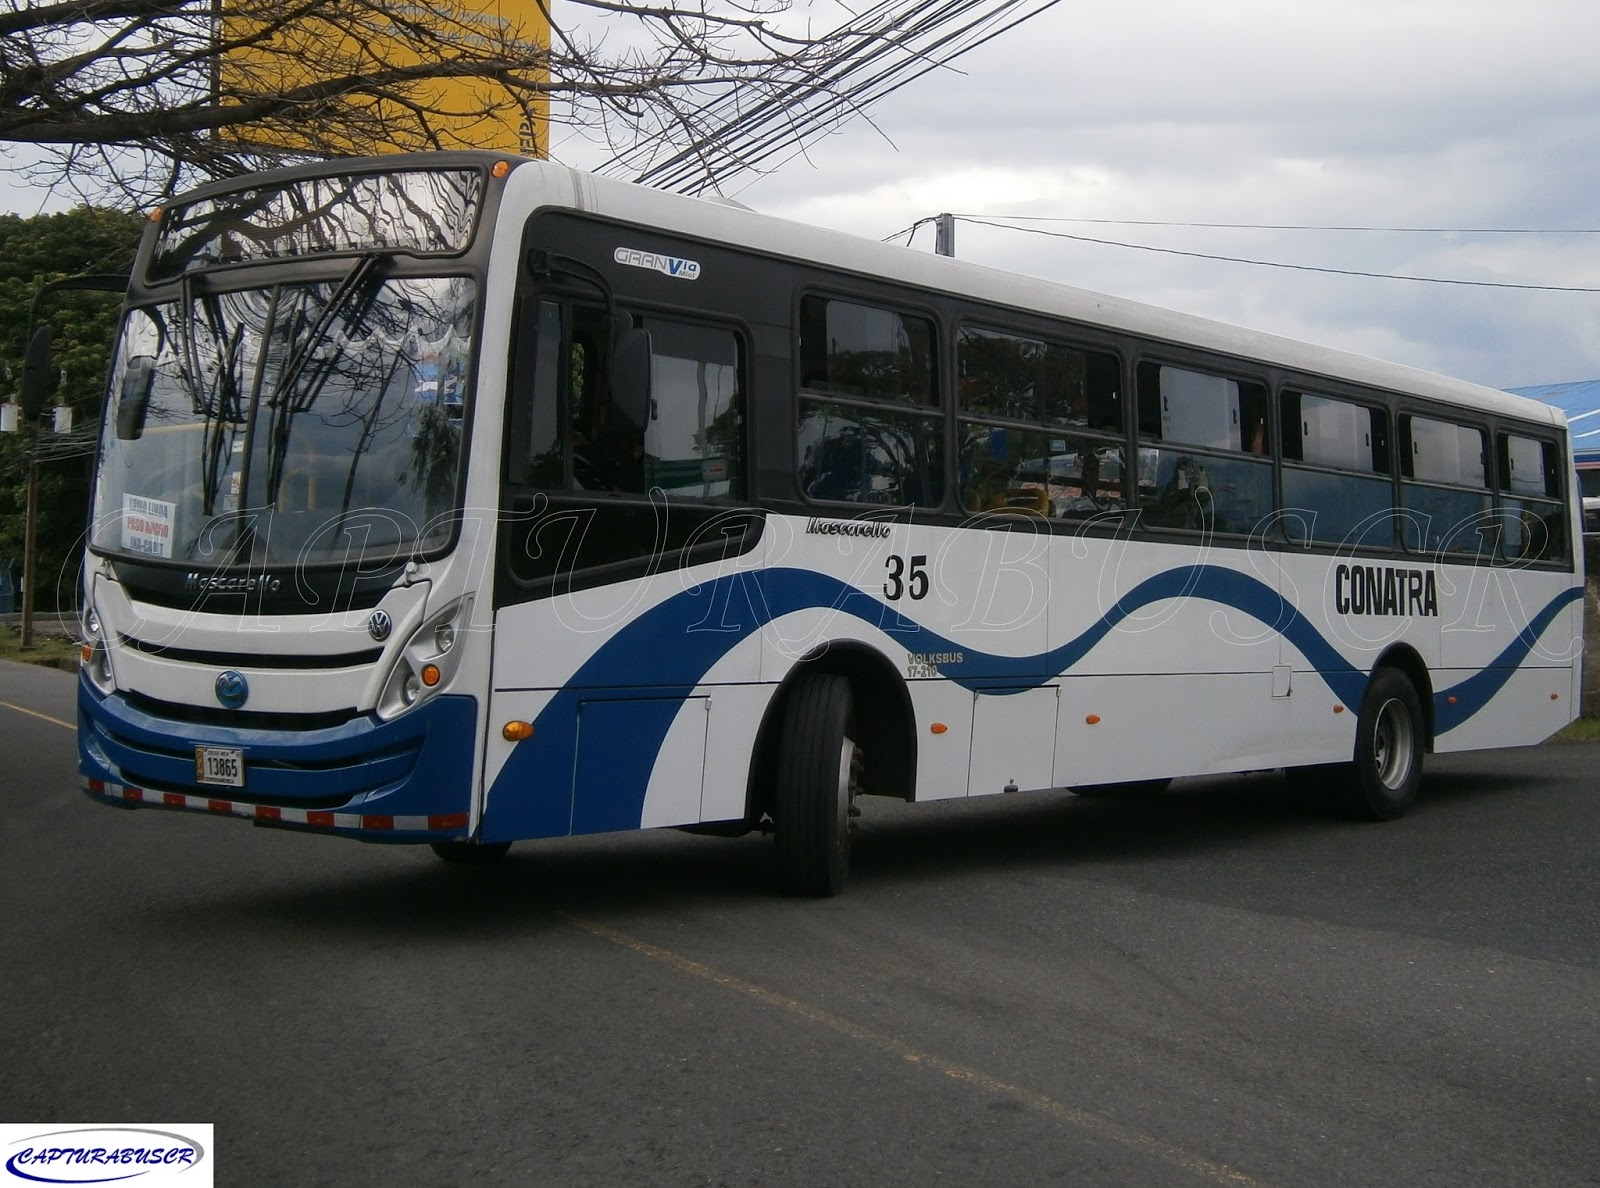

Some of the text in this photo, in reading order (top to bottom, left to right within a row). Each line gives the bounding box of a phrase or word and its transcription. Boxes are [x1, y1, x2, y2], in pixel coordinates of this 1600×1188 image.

[127, 516, 145, 533] PASO
[806, 516, 891, 539] Mascarello
[185, 572, 281, 592] Mascarello
[883, 554, 929, 601] 35
[1335, 564, 1438, 617] CONATRA
[906, 652, 964, 665] VOLKSBUS
[906, 665, 938, 678] 17-210
[207, 756, 237, 777] 13865
